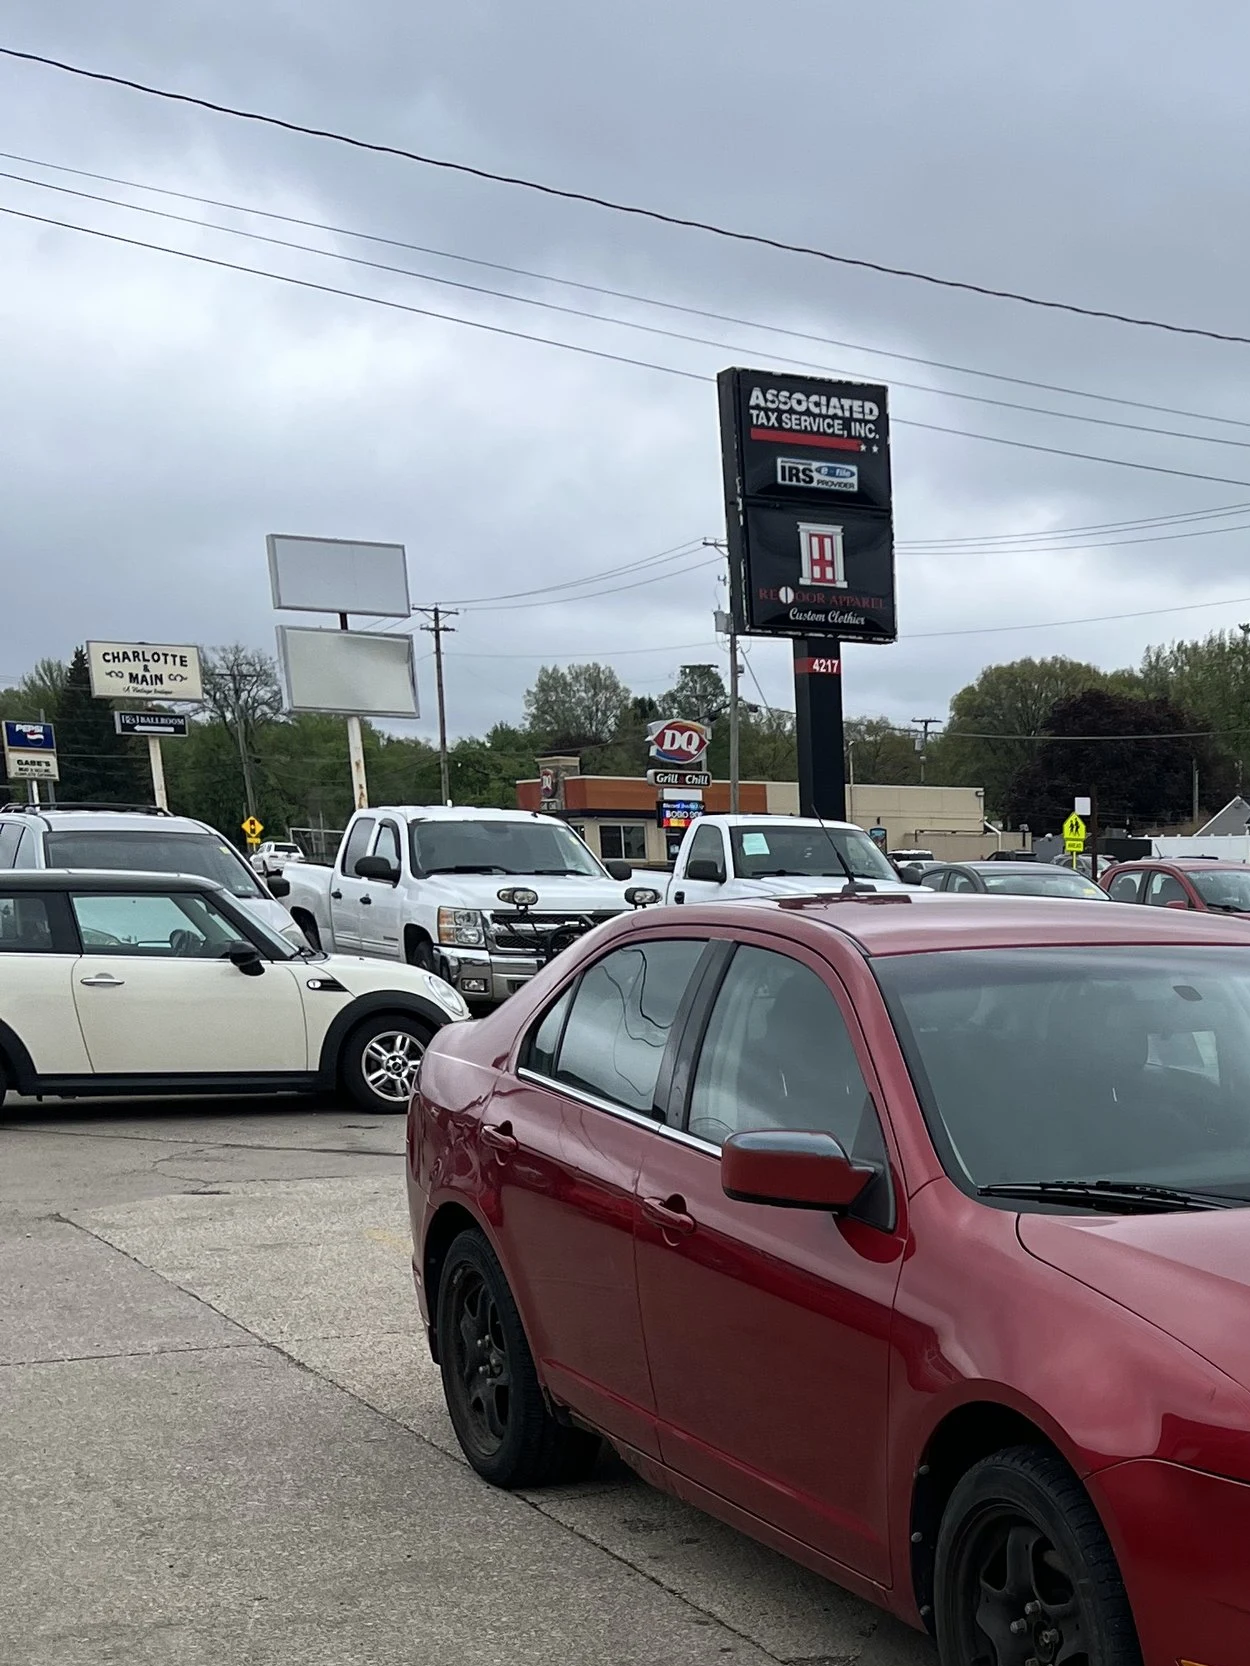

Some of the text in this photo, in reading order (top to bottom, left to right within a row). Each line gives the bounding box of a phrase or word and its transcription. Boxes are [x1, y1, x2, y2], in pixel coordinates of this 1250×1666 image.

[749, 387, 879, 421] ASSOCIATED
[749, 409, 880, 439] TAX SERVICE, INC.
[781, 465, 814, 485] IRS
[816, 479, 855, 489] PROVIDER
[830, 595, 886, 609] APPAREL
[789, 607, 865, 625] Custom Clothier
[102, 650, 188, 668] CHARLOTTE
[812, 658, 839, 673] 4217
[143, 664, 151, 673] &
[128, 672, 164, 686] MAIN
[662, 729, 700, 755] DQ
[656, 773, 679, 784] Grill
[685, 774, 709, 785] Chill
